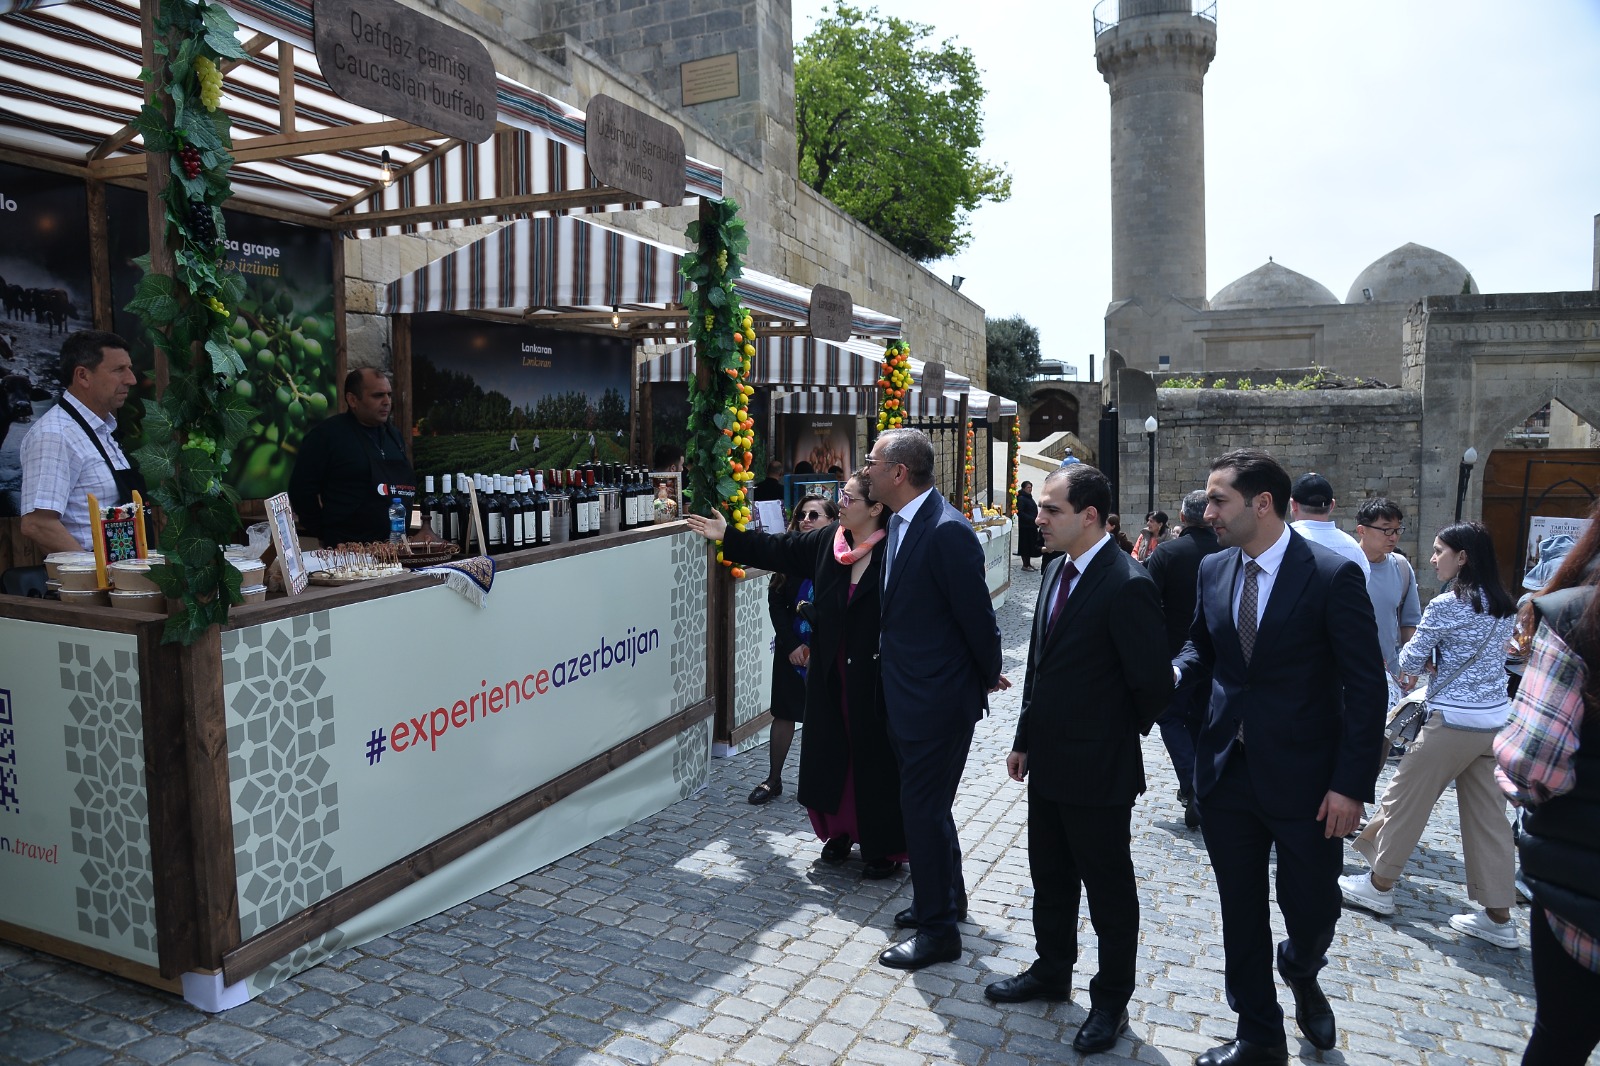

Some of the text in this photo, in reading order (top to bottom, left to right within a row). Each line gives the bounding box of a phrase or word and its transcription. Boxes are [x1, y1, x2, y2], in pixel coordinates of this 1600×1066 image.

[350, 11, 413, 58] Qafqaz
[334, 43, 485, 121] Caucasian buffalo
[625, 158, 653, 182] wines
[242, 242, 281, 259] grape
[238, 258, 280, 277] üzümü
[521, 342, 553, 355] Lankaran
[365, 626, 660, 767] #experienceazerbaijan
[0, 836, 59, 865] n.travel
